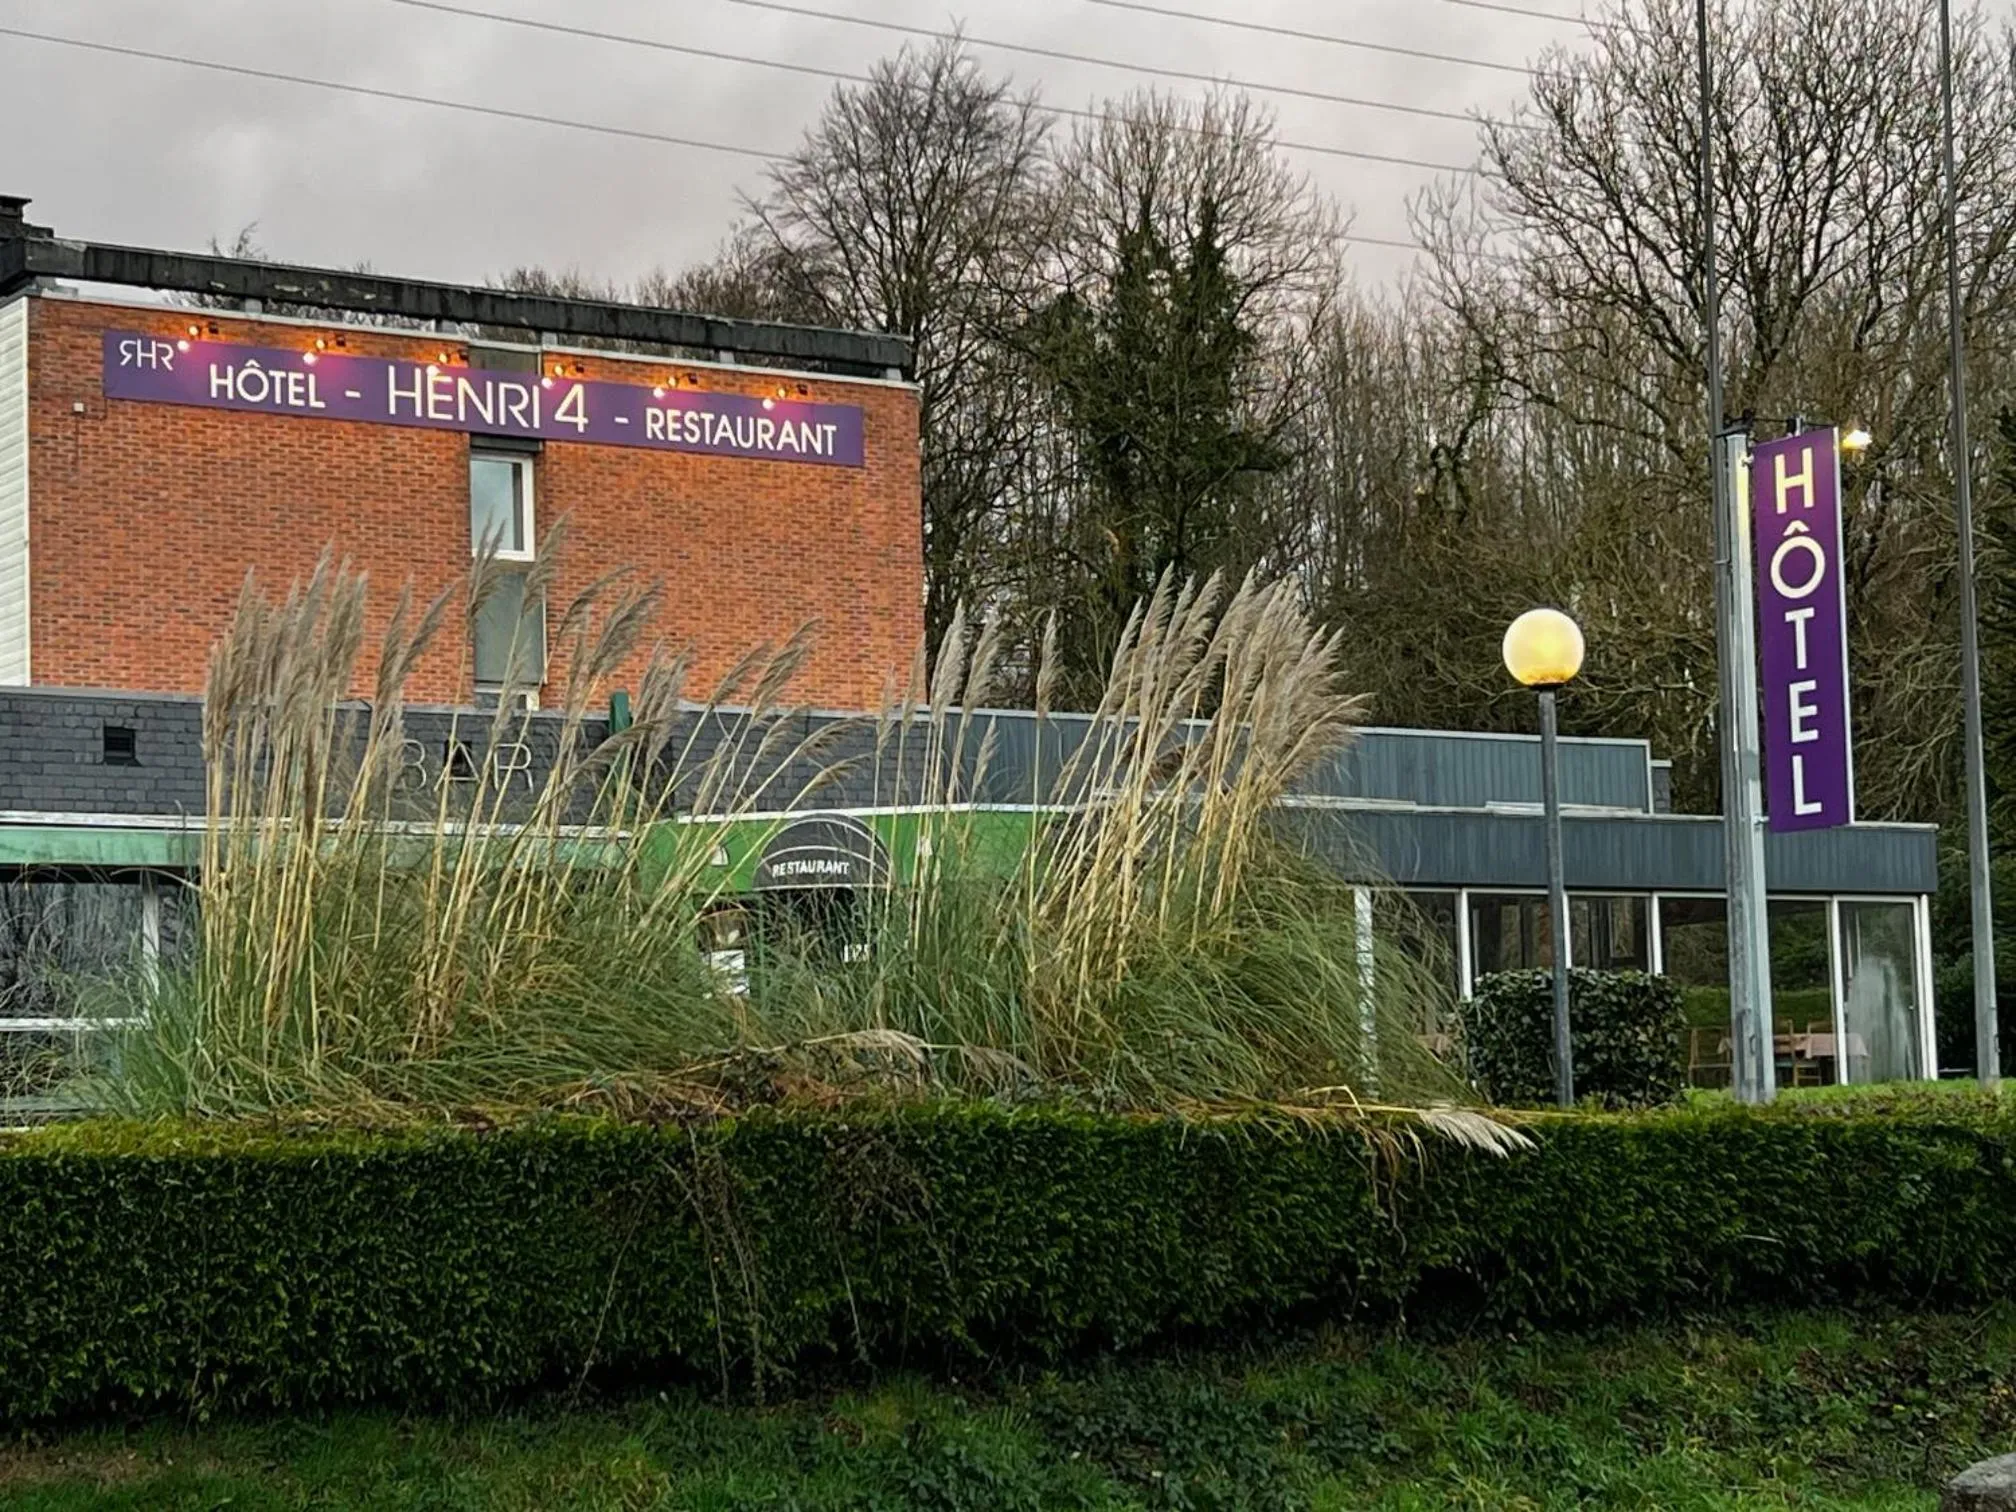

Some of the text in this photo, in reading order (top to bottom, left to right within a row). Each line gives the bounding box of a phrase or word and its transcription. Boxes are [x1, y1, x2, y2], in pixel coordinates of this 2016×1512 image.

[209, 359, 326, 409] HÔTEL
[388, 364, 541, 430] HENRI
[554, 383, 589, 433] 4
[645, 407, 838, 456] RESTAURANT
[1770, 447, 1826, 816] HÔTEL
[400, 738, 534, 794] BAR
[772, 859, 850, 878] RESTAURANT
